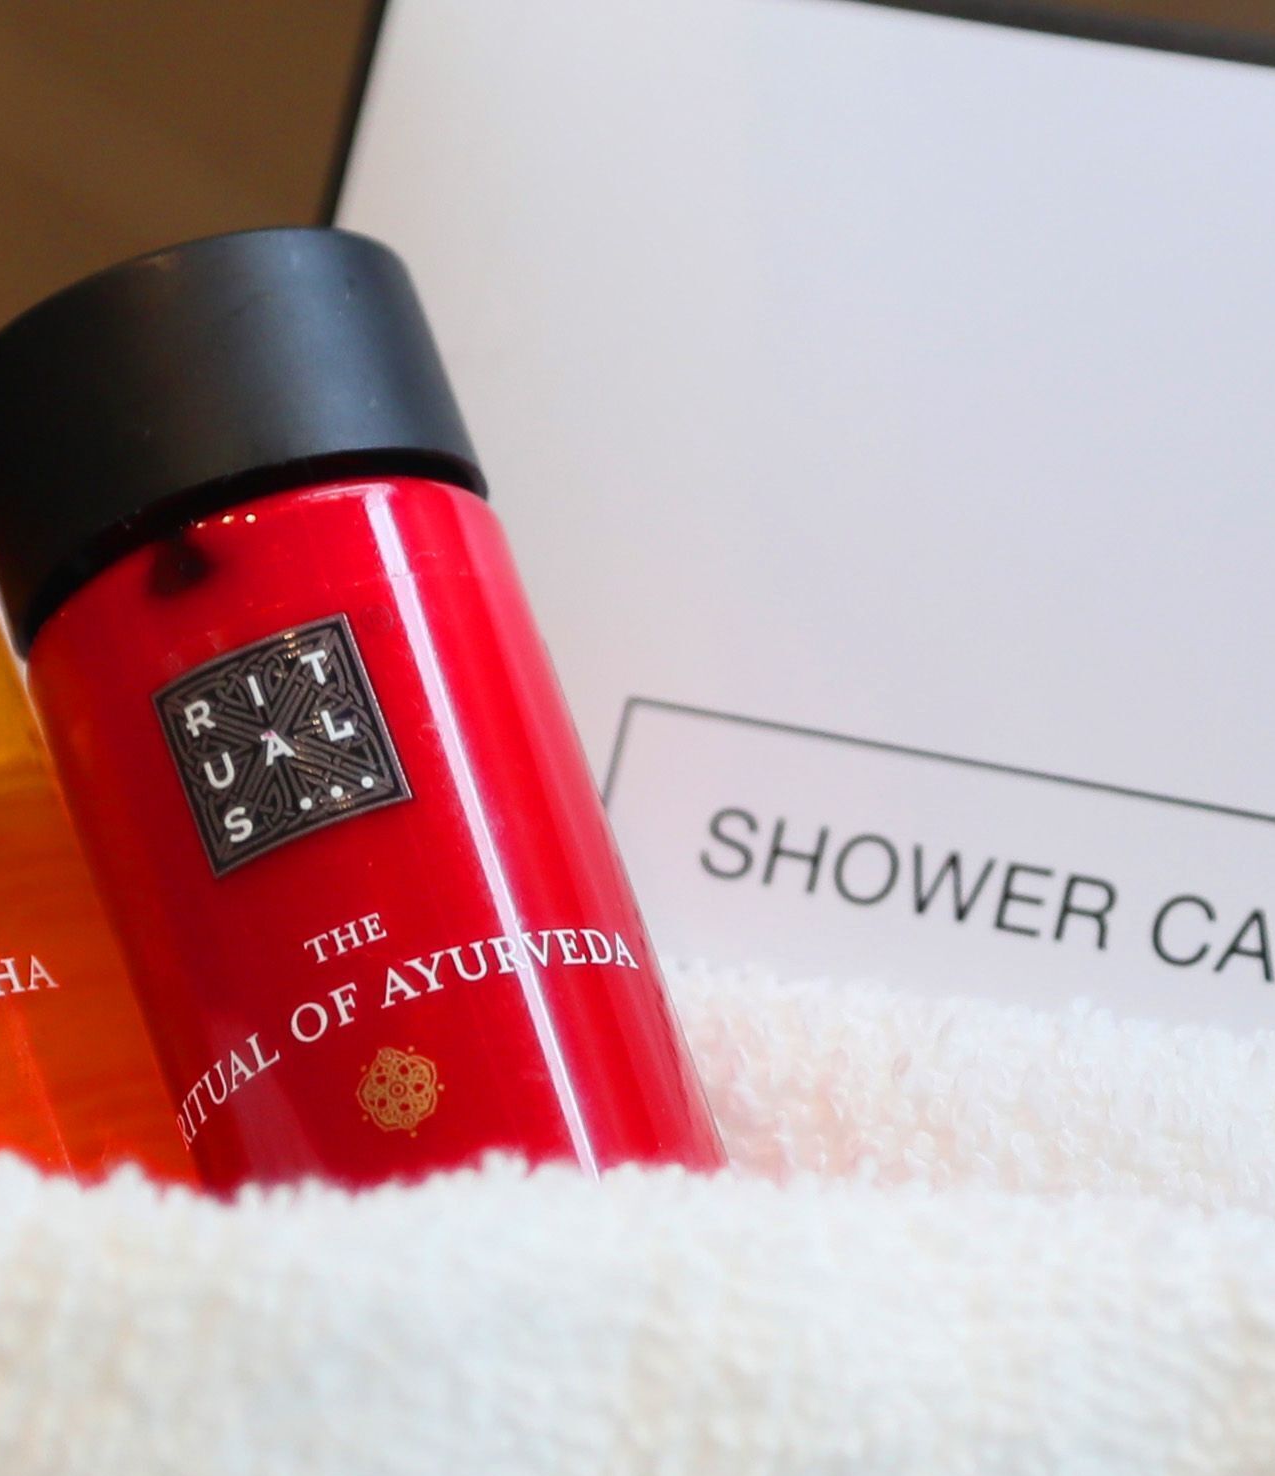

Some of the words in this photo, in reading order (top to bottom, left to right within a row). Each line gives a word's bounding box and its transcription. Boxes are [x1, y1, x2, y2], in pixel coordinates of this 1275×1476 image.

[303, 913, 388, 964] THE
[698, 806, 1119, 951] SHOWER
[176, 1031, 281, 1150] RITUAL
[289, 983, 359, 1042] OF
[380, 928, 639, 1009] AYURVEDA
